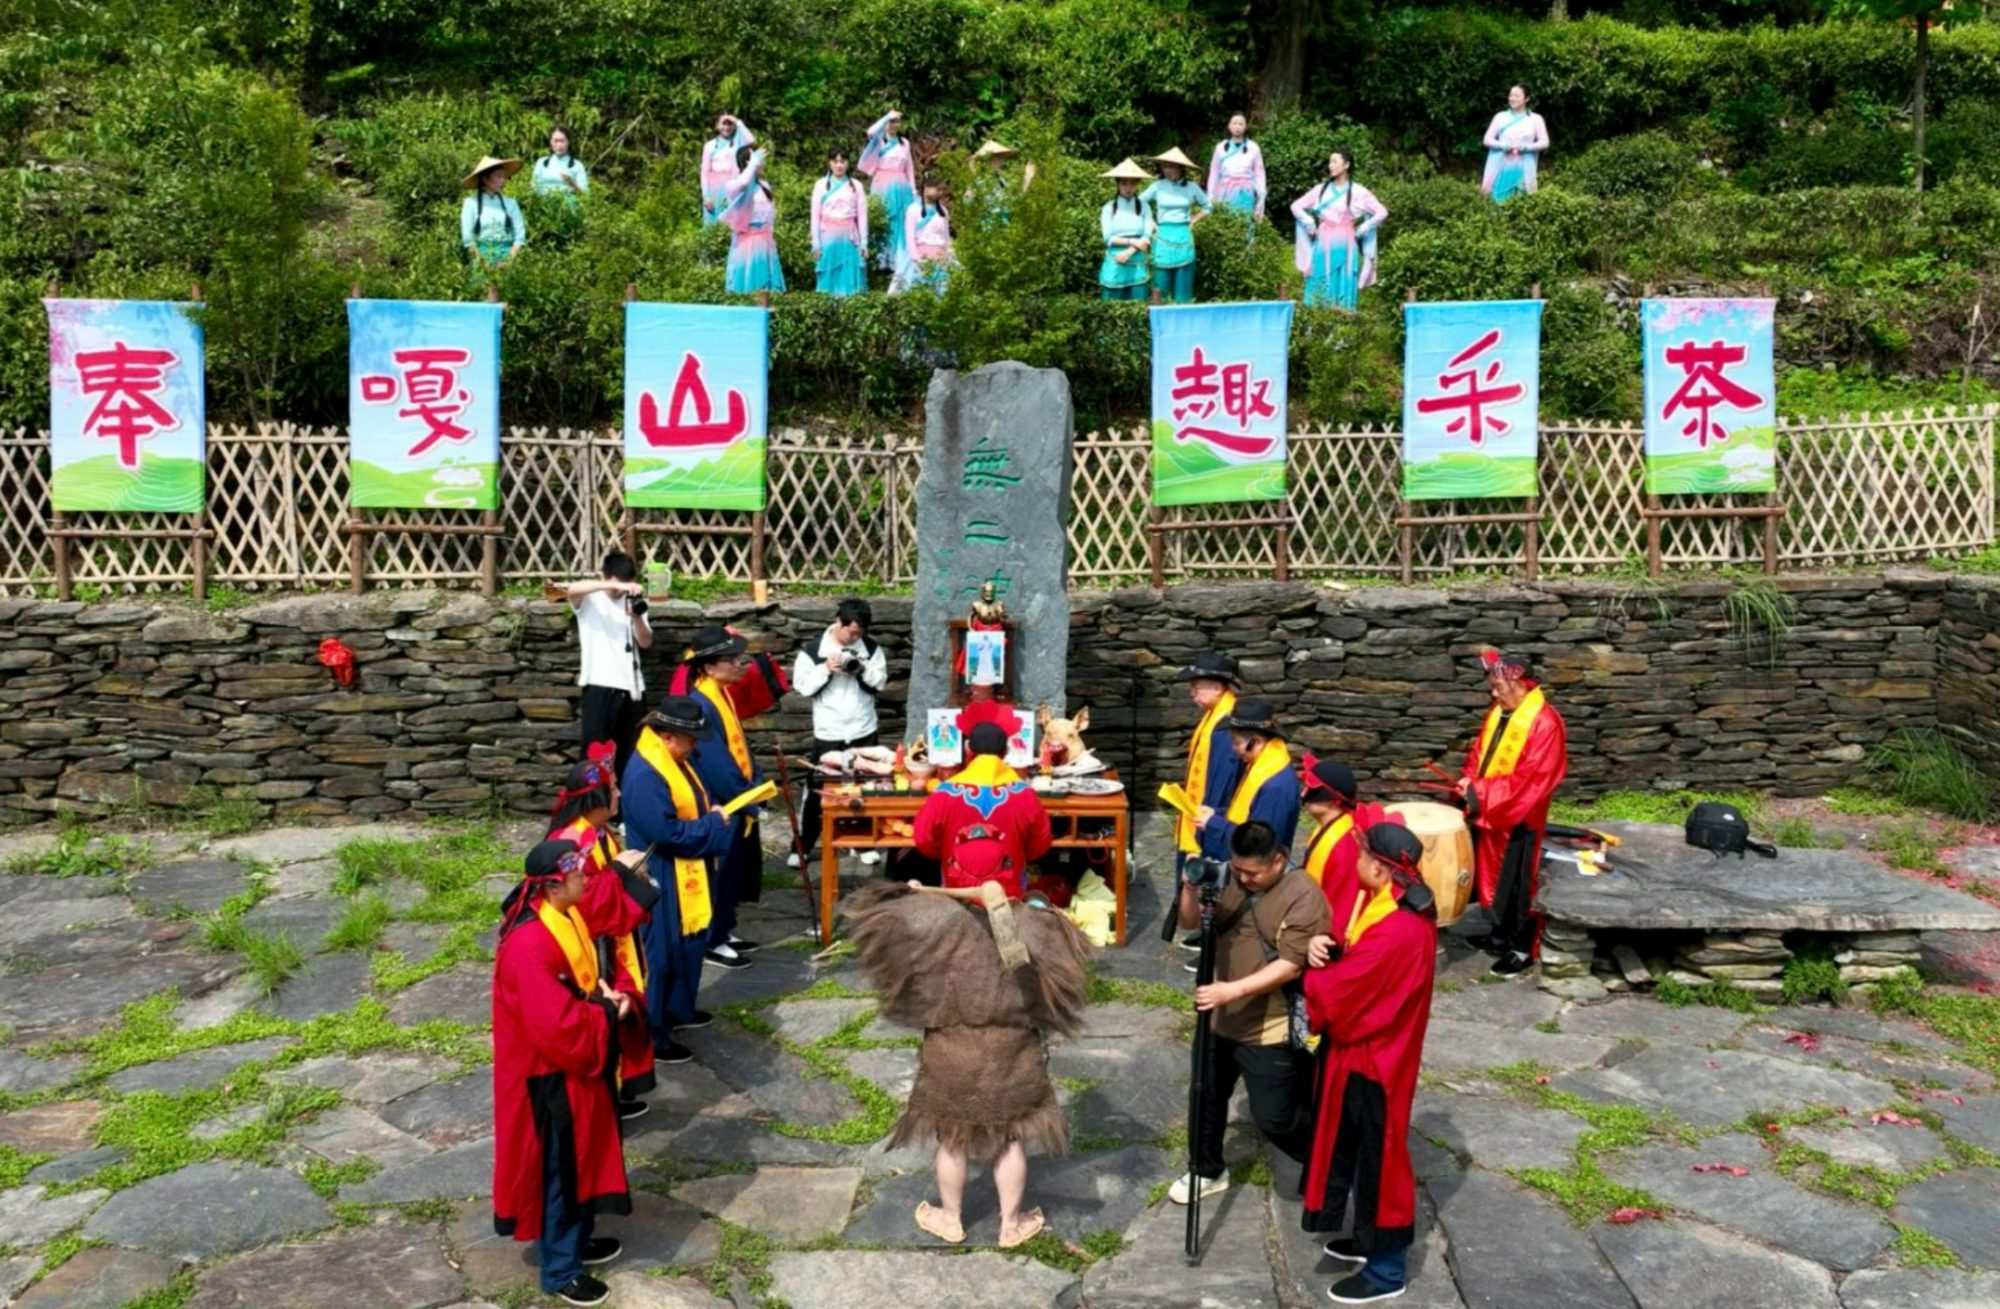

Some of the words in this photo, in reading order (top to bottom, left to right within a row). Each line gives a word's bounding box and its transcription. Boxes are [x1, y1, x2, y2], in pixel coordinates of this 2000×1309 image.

[75, 343, 177, 467] 奉
[362, 350, 471, 456] 嘎
[640, 354, 746, 446] 山
[1172, 348, 1275, 455] 趣
[1417, 331, 1523, 442] 采
[1663, 341, 1763, 447] 茶
